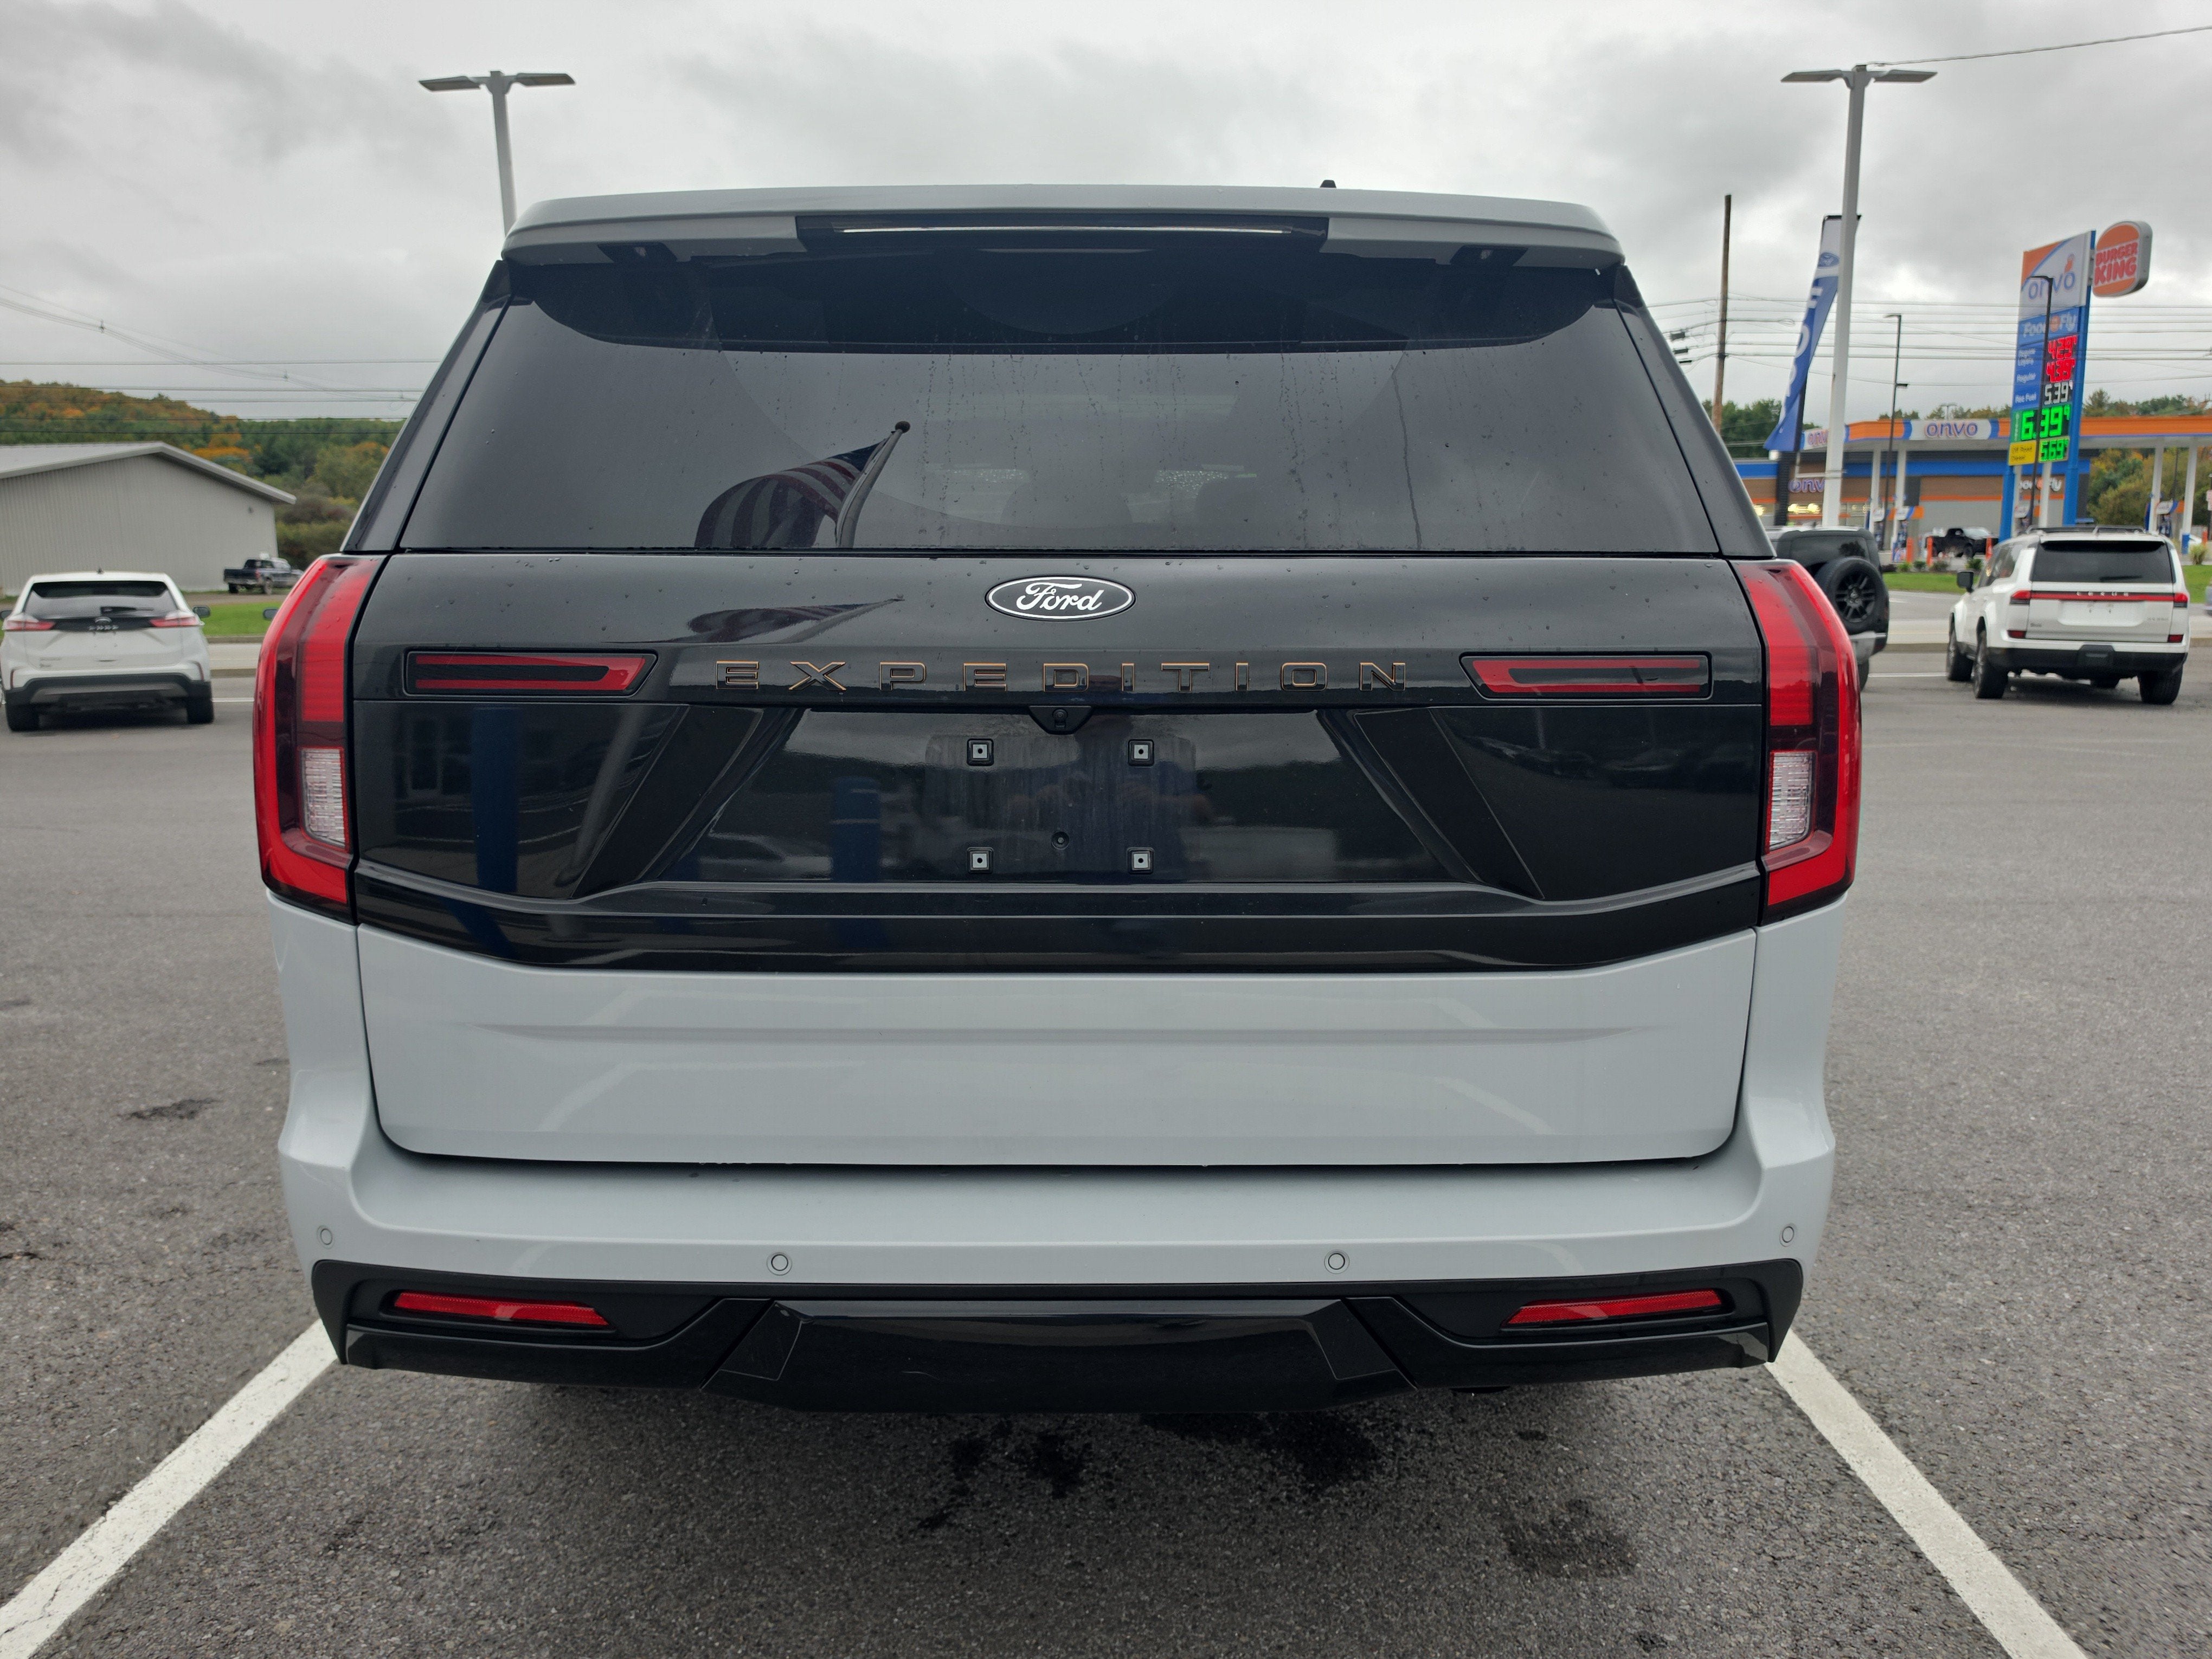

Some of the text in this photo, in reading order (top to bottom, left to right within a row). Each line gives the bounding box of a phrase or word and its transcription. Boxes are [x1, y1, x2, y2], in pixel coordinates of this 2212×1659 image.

[2095, 242, 2138, 266] BURGER
[2094, 256, 2137, 286] KING
[1808, 430, 1829, 446] onv
[1925, 422, 1978, 437] onvo
[1788, 478, 1825, 493] onv
[1016, 582, 1104, 610] Ford
[715, 660, 1406, 692] EXPEDITION
